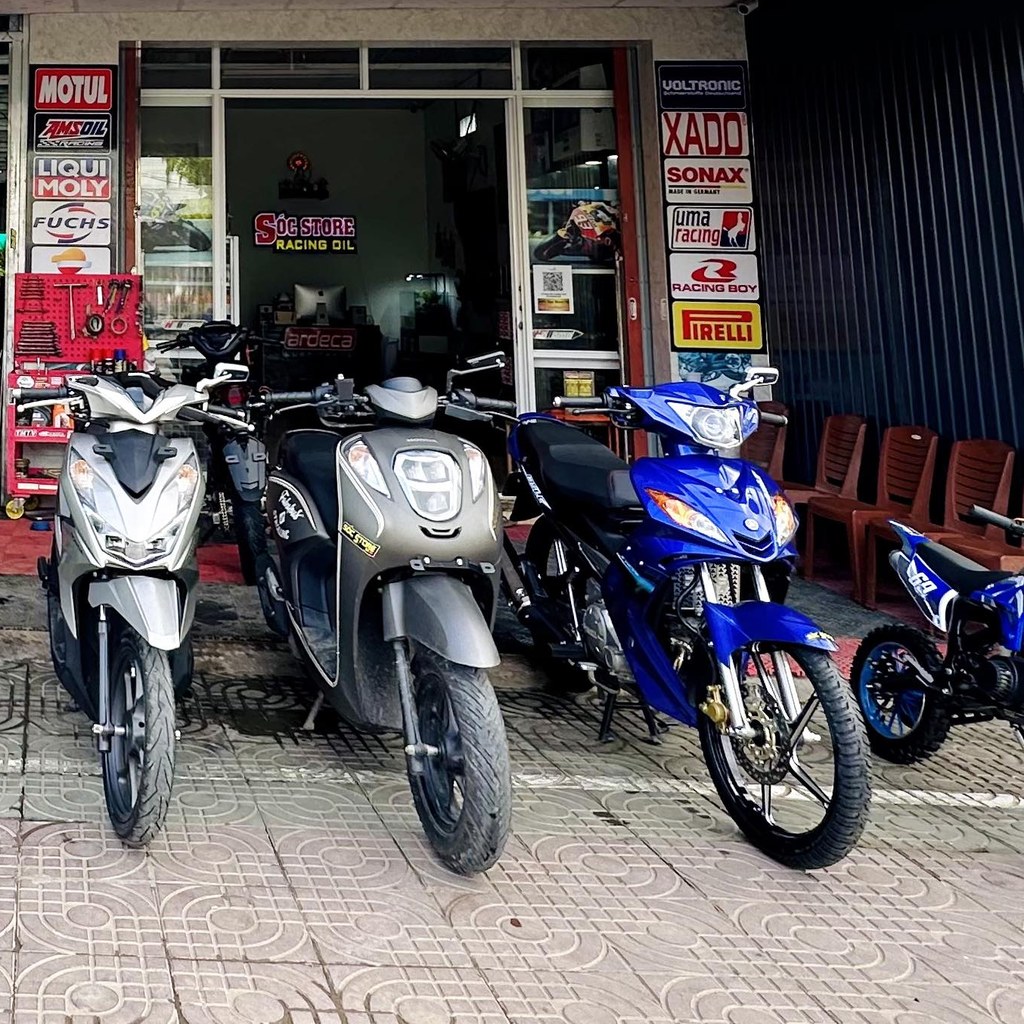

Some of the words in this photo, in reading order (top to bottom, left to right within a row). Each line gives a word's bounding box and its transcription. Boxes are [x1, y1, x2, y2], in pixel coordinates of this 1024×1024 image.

[38, 74, 109, 105] MOTUL
[662, 79, 742, 91] VOLTRONIC
[38, 119, 108, 141] AMSOIL
[663, 112, 744, 155] XADO
[38, 159, 107, 178] LIQUI
[667, 167, 746, 183] SONAX
[37, 179, 110, 197] MOLY
[33, 216, 110, 229] FUCHS
[675, 210, 711, 227] uma
[255, 213, 298, 245] SÓC
[300, 217, 355, 236] STORE
[675, 228, 721, 247] racing
[276, 239, 327, 250] RACING
[332, 240, 355, 250] OIL
[672, 283, 725, 293] RACING
[728, 284, 758, 293] BOY
[681, 309, 753, 342] PIRELLI
[286, 330, 353, 347] ardeca
